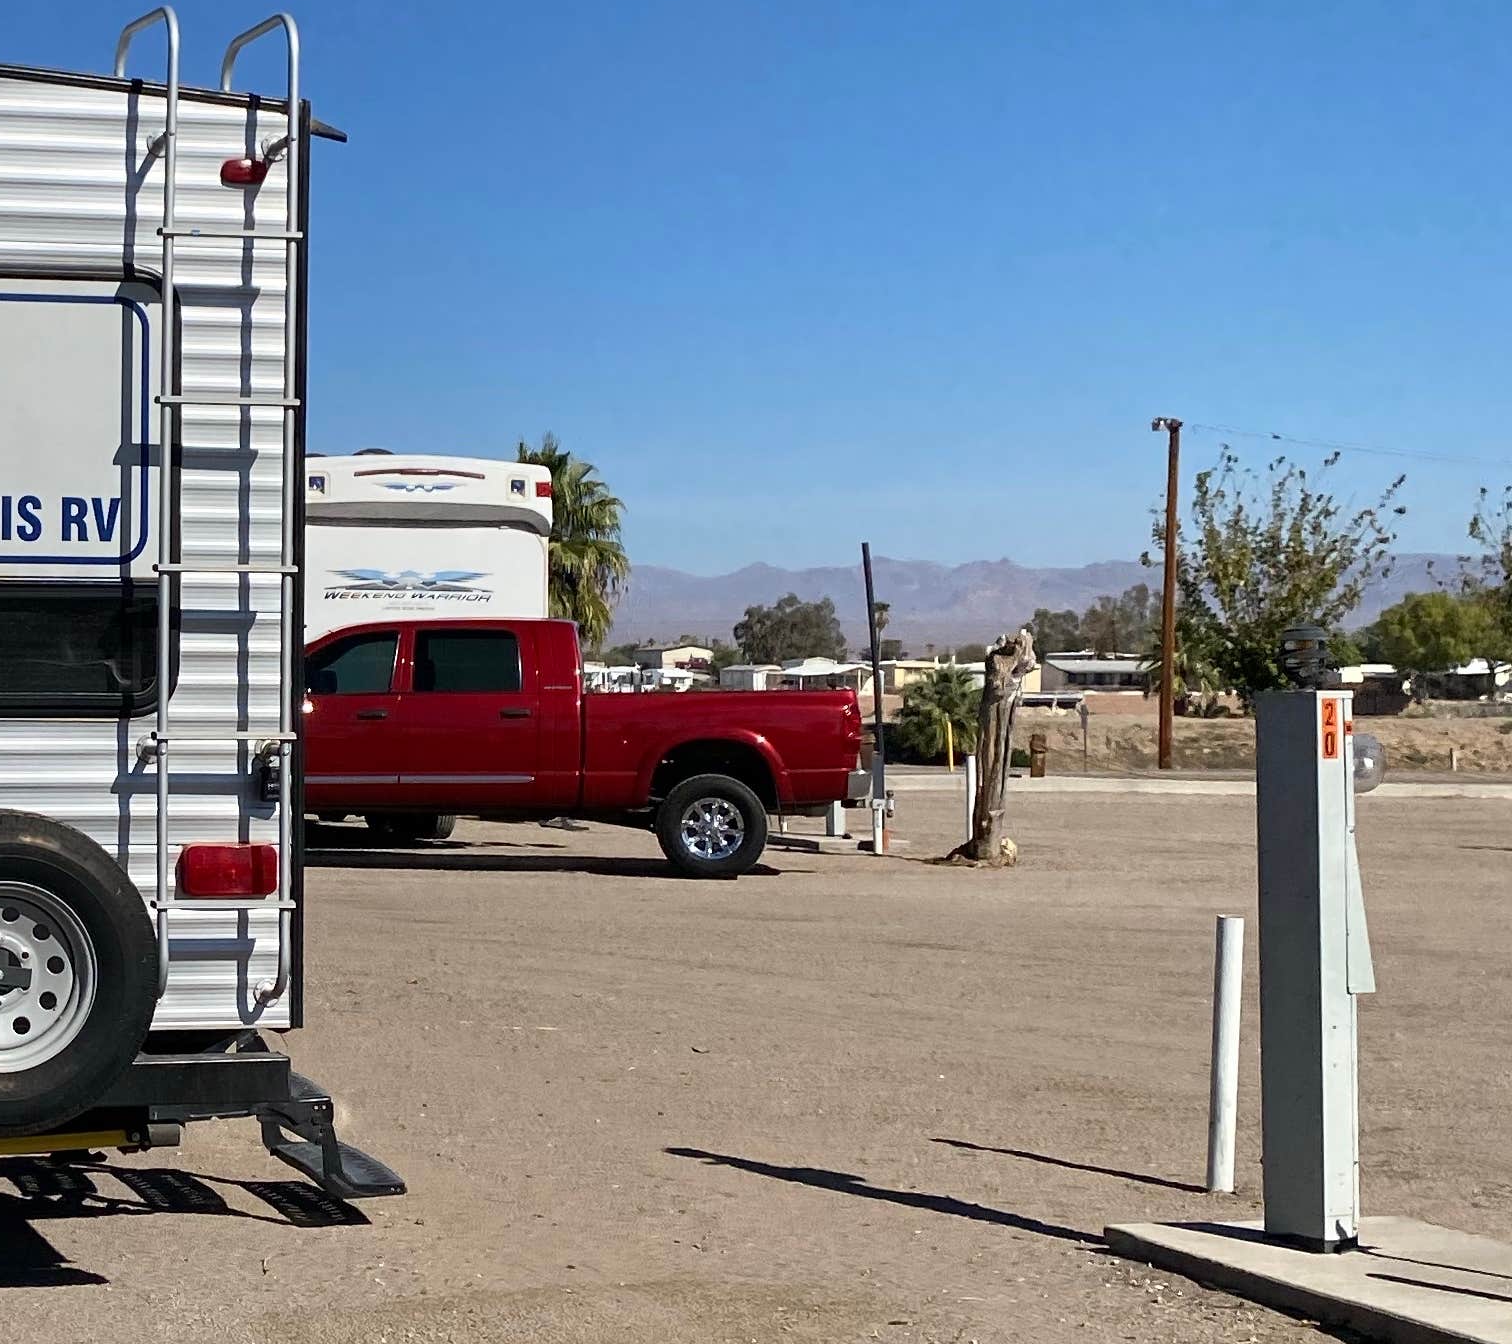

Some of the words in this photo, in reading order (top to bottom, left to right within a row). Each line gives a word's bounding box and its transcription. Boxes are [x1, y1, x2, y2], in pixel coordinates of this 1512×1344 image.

[60, 496, 123, 543] RV
[324, 591, 407, 600] WEEKEND
[410, 592, 492, 603] WARRIOR
